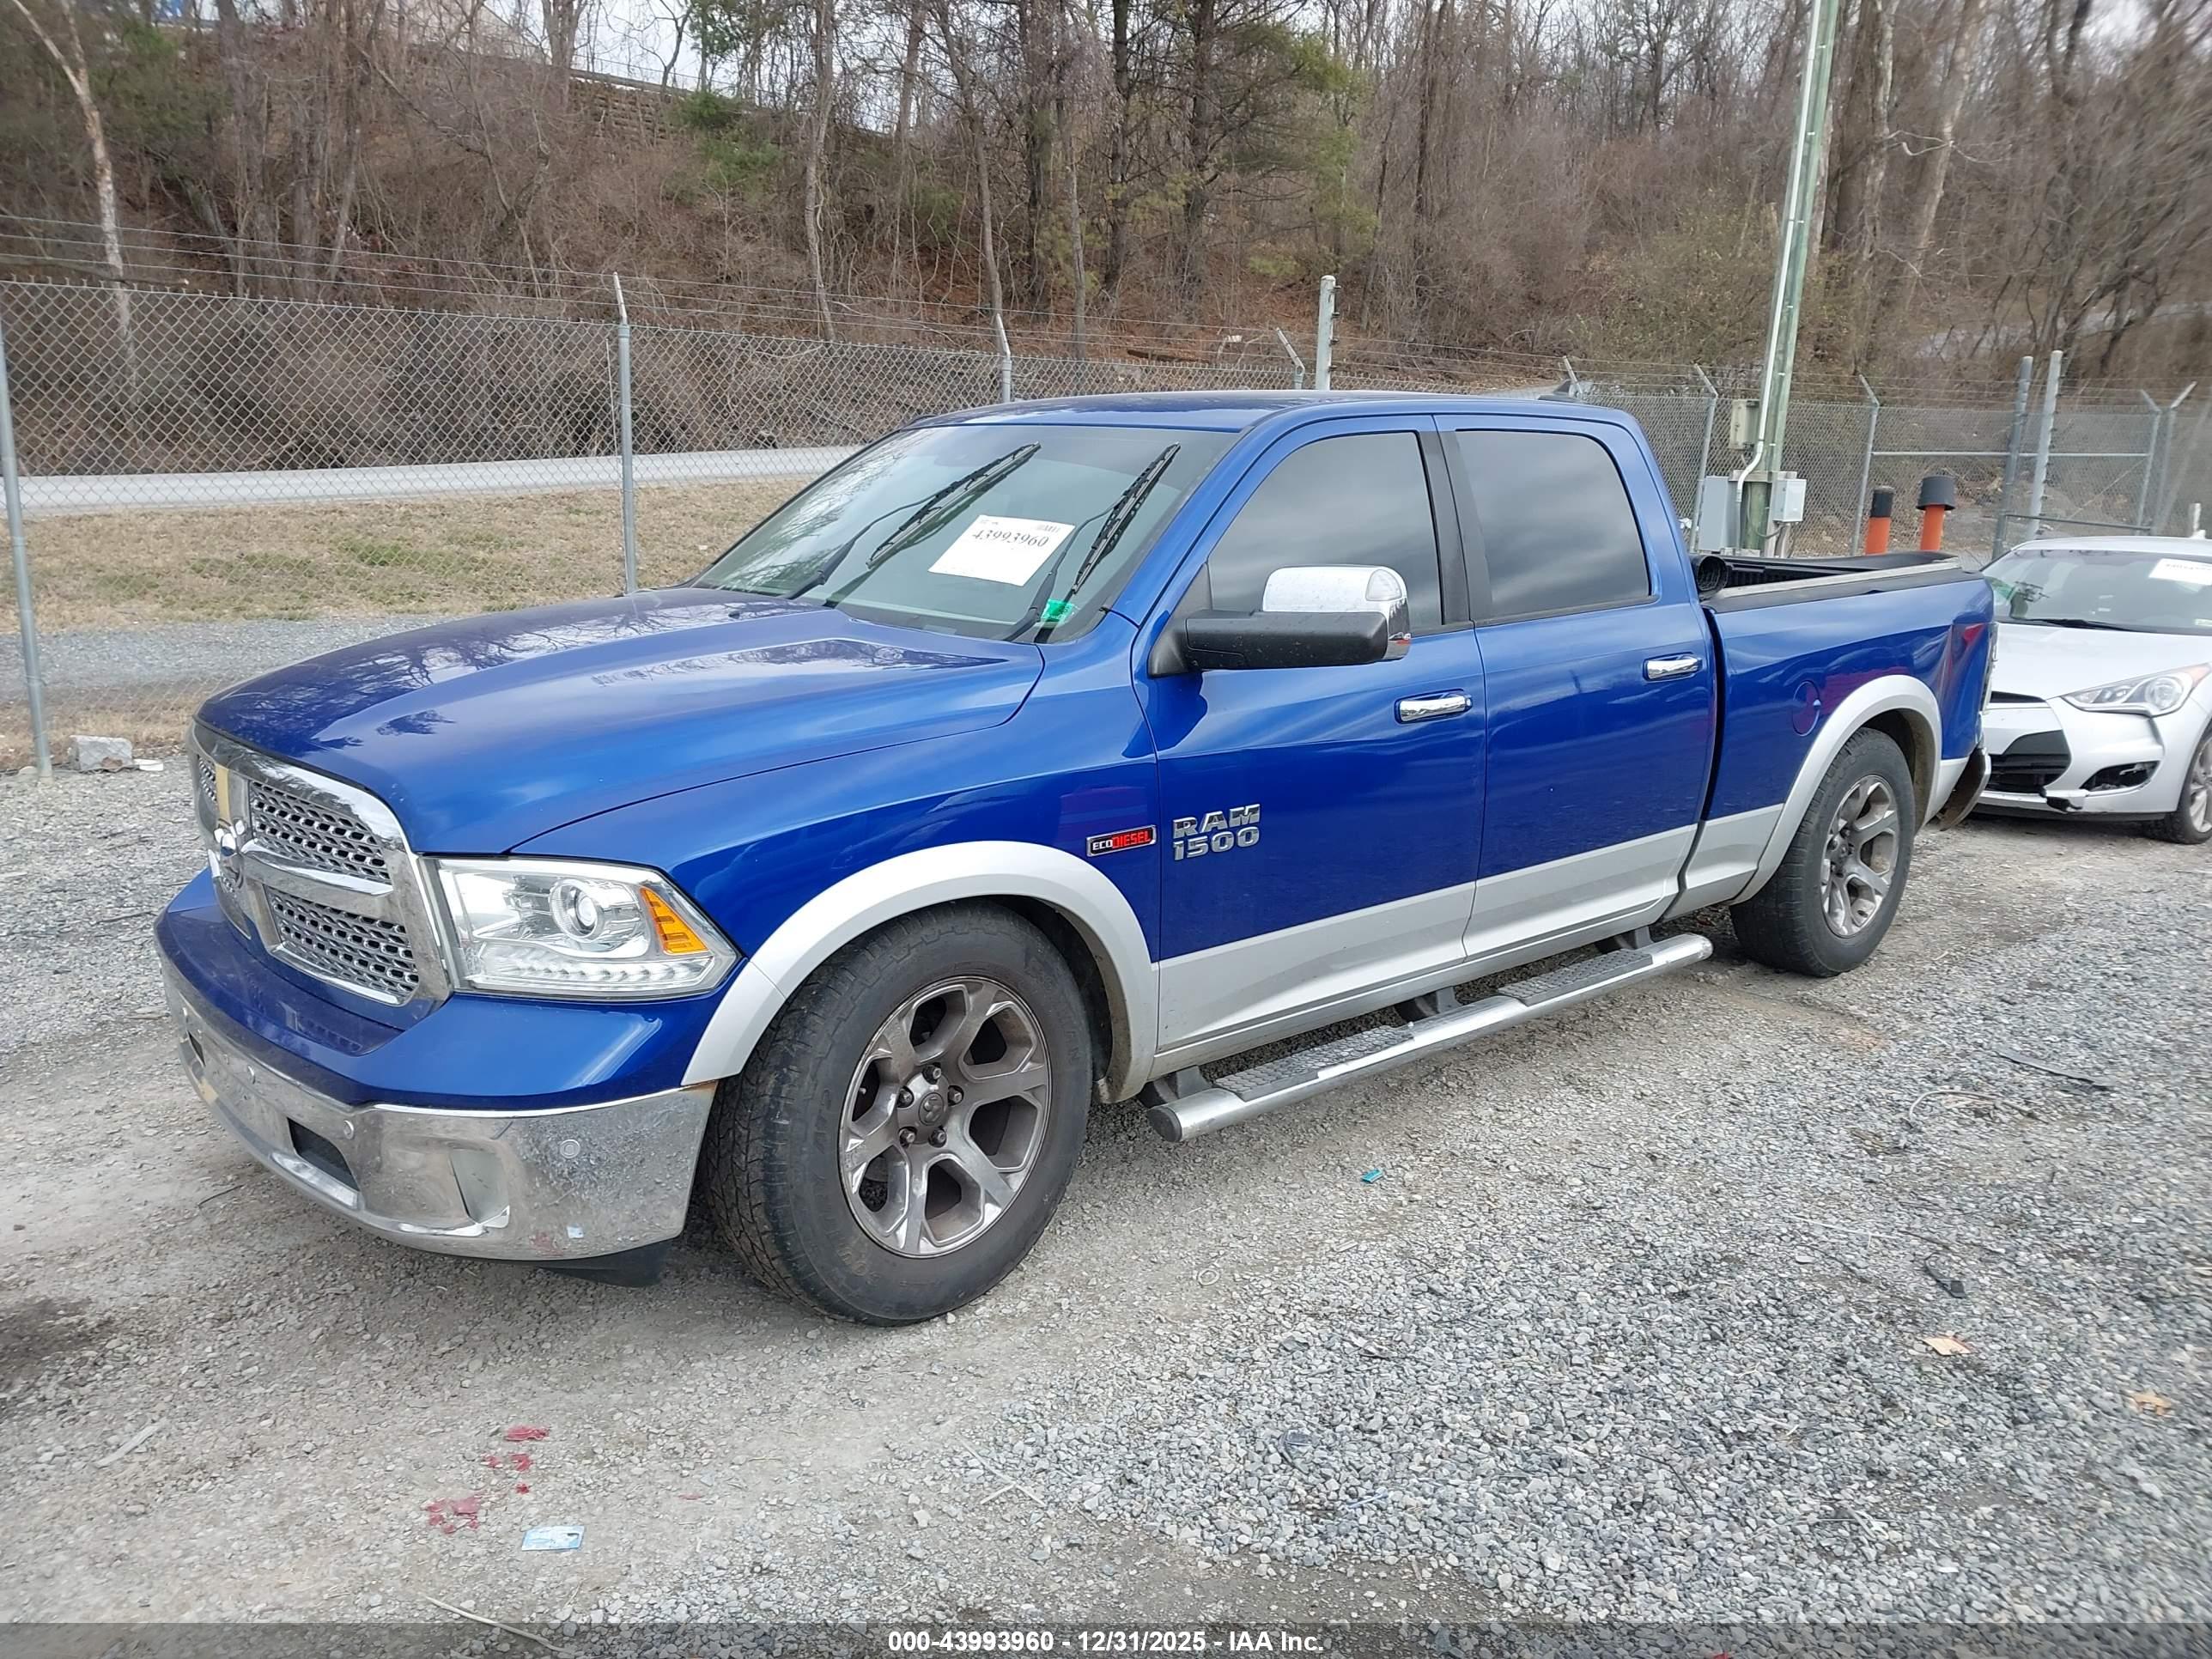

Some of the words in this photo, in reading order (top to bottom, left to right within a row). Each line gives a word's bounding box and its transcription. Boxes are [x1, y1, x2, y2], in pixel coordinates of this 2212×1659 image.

[971, 529, 1049, 547] 43993960
[1173, 804, 1261, 839] RAM
[1173, 826, 1260, 860] 1500
